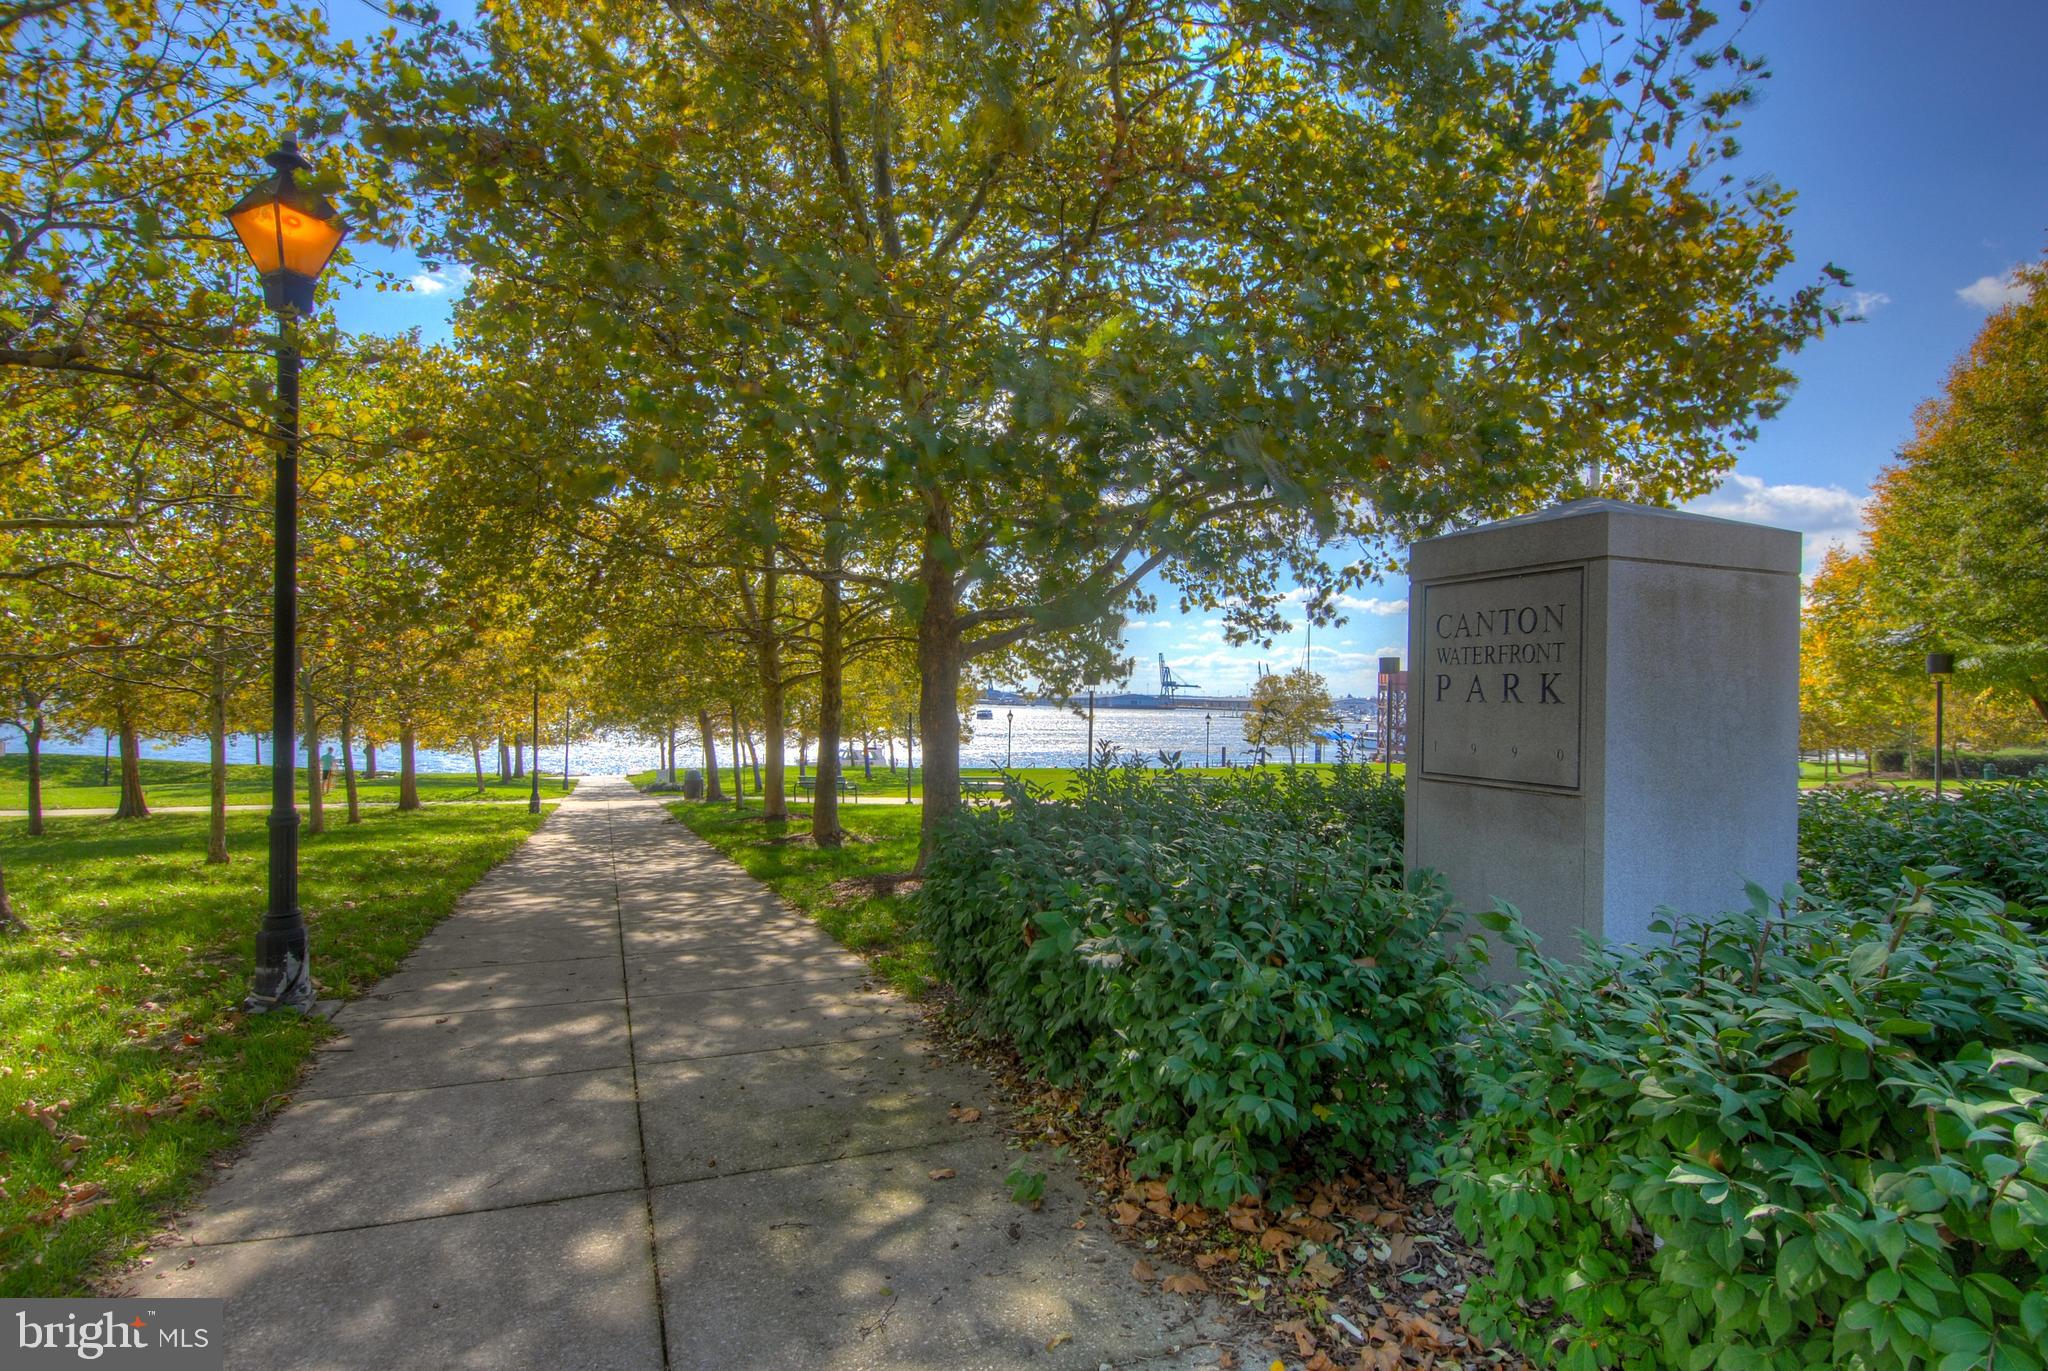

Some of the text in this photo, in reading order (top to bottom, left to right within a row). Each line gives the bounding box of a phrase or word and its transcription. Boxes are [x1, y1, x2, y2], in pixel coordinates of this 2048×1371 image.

[1436, 604, 1566, 639] CANTON
[1437, 642, 1565, 666] WATERFRONT
[1436, 672, 1565, 704] PARK
[1433, 740, 1565, 762] 1990
